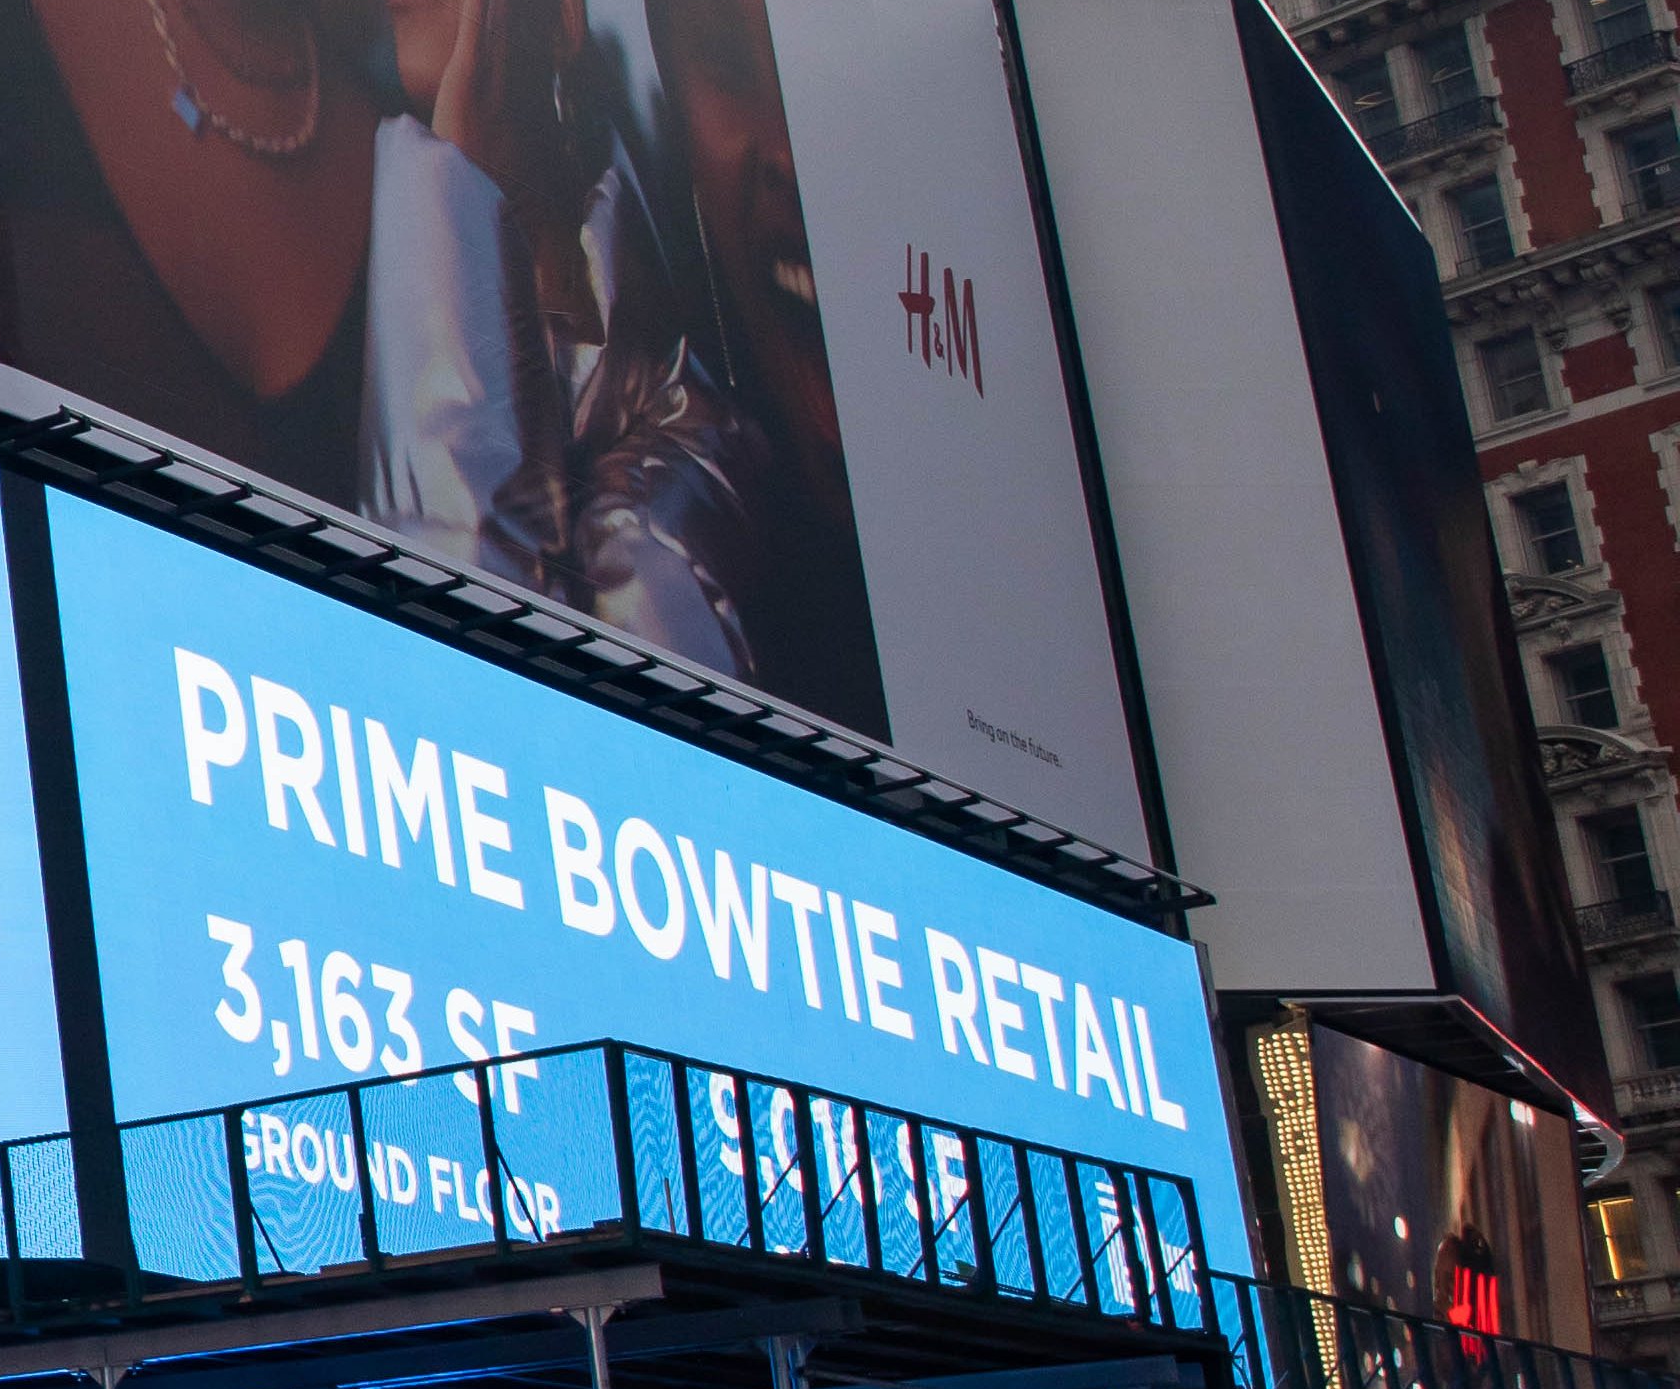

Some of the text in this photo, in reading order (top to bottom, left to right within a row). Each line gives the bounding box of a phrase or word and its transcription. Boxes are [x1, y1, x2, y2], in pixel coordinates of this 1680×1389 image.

[898, 243, 984, 400] H&M
[966, 708, 996, 743] Bring
[996, 728, 1010, 746] on
[1010, 731, 1028, 753] the
[173, 647, 1187, 1131] PRIME BOWTIE RETAIL
[205, 913, 540, 1115] 3,163 SF
[430, 1153, 561, 1237] FLOOR
[1447, 1264, 1502, 1366] HM
